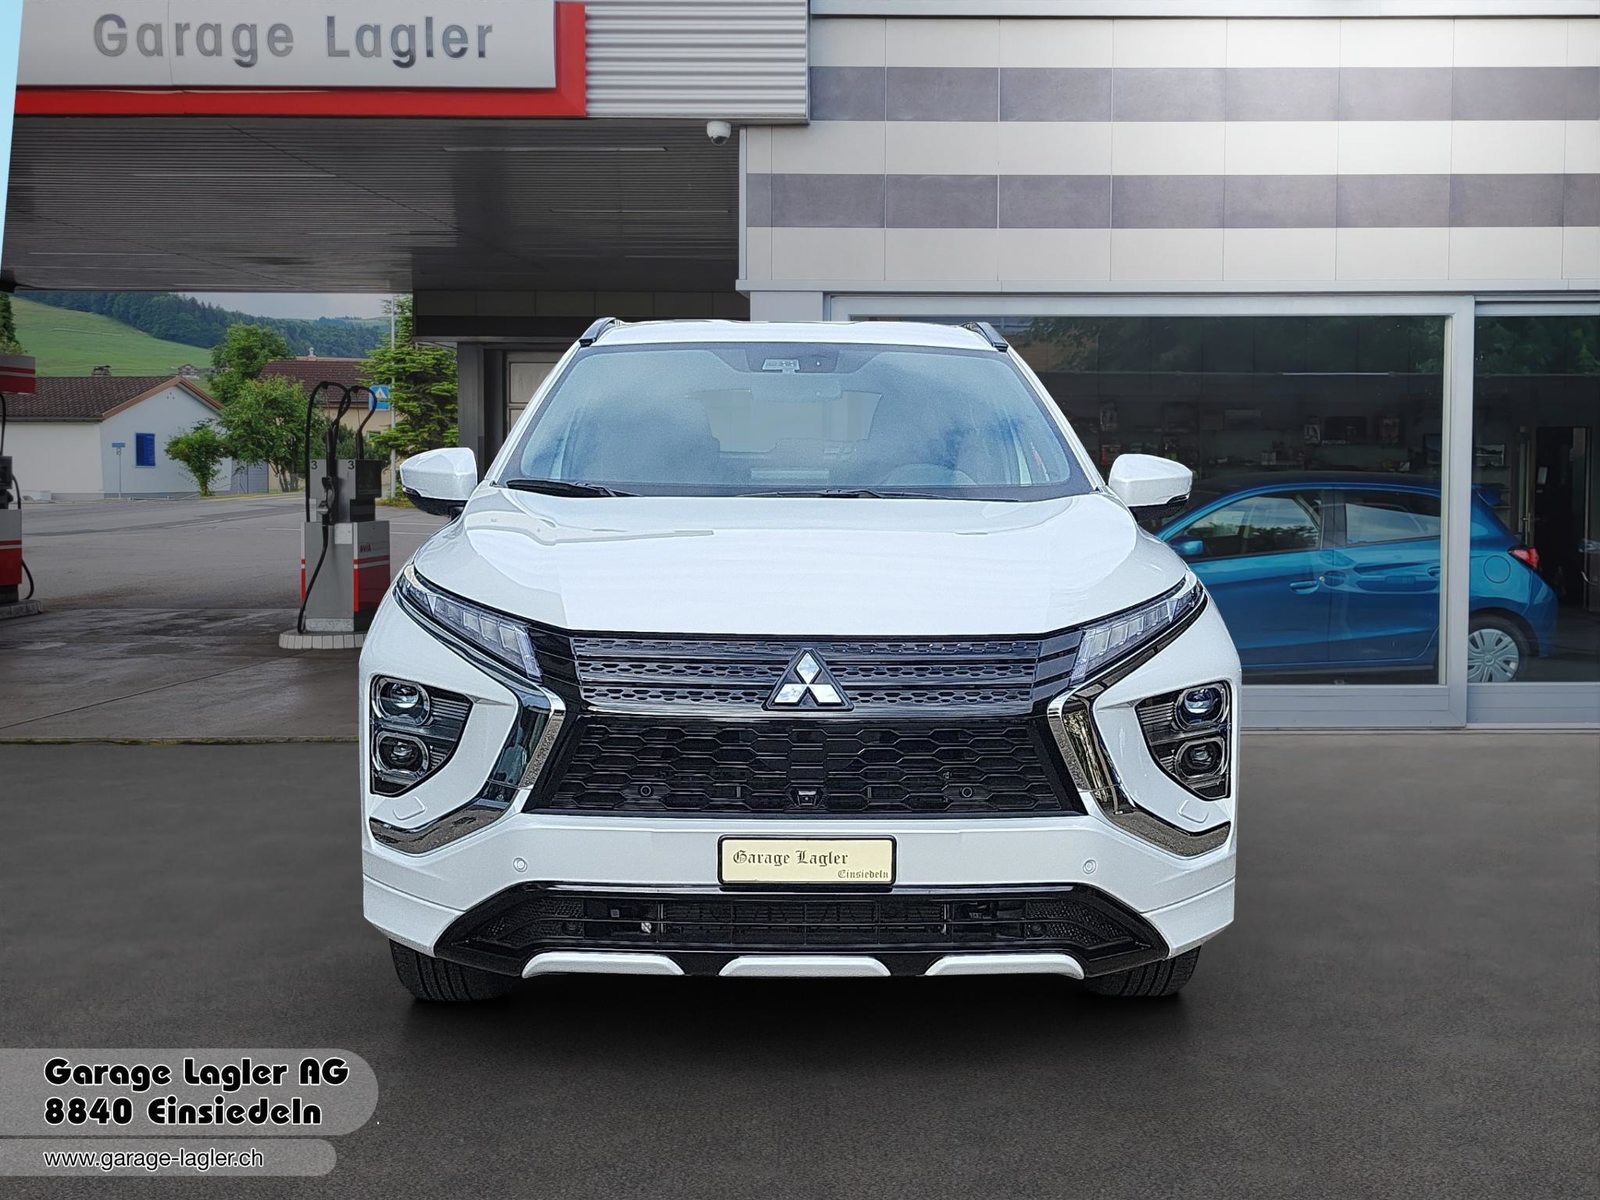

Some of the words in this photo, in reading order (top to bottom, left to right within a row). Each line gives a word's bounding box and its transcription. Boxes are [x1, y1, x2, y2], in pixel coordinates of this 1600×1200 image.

[93, 13, 295, 69] Garage
[326, 15, 494, 70] Lagler
[311, 460, 318, 470] 3
[347, 460, 355, 470] 3
[732, 849, 790, 867] Garage
[795, 849, 849, 867] Lagler
[837, 869, 889, 879] Einsiedeln
